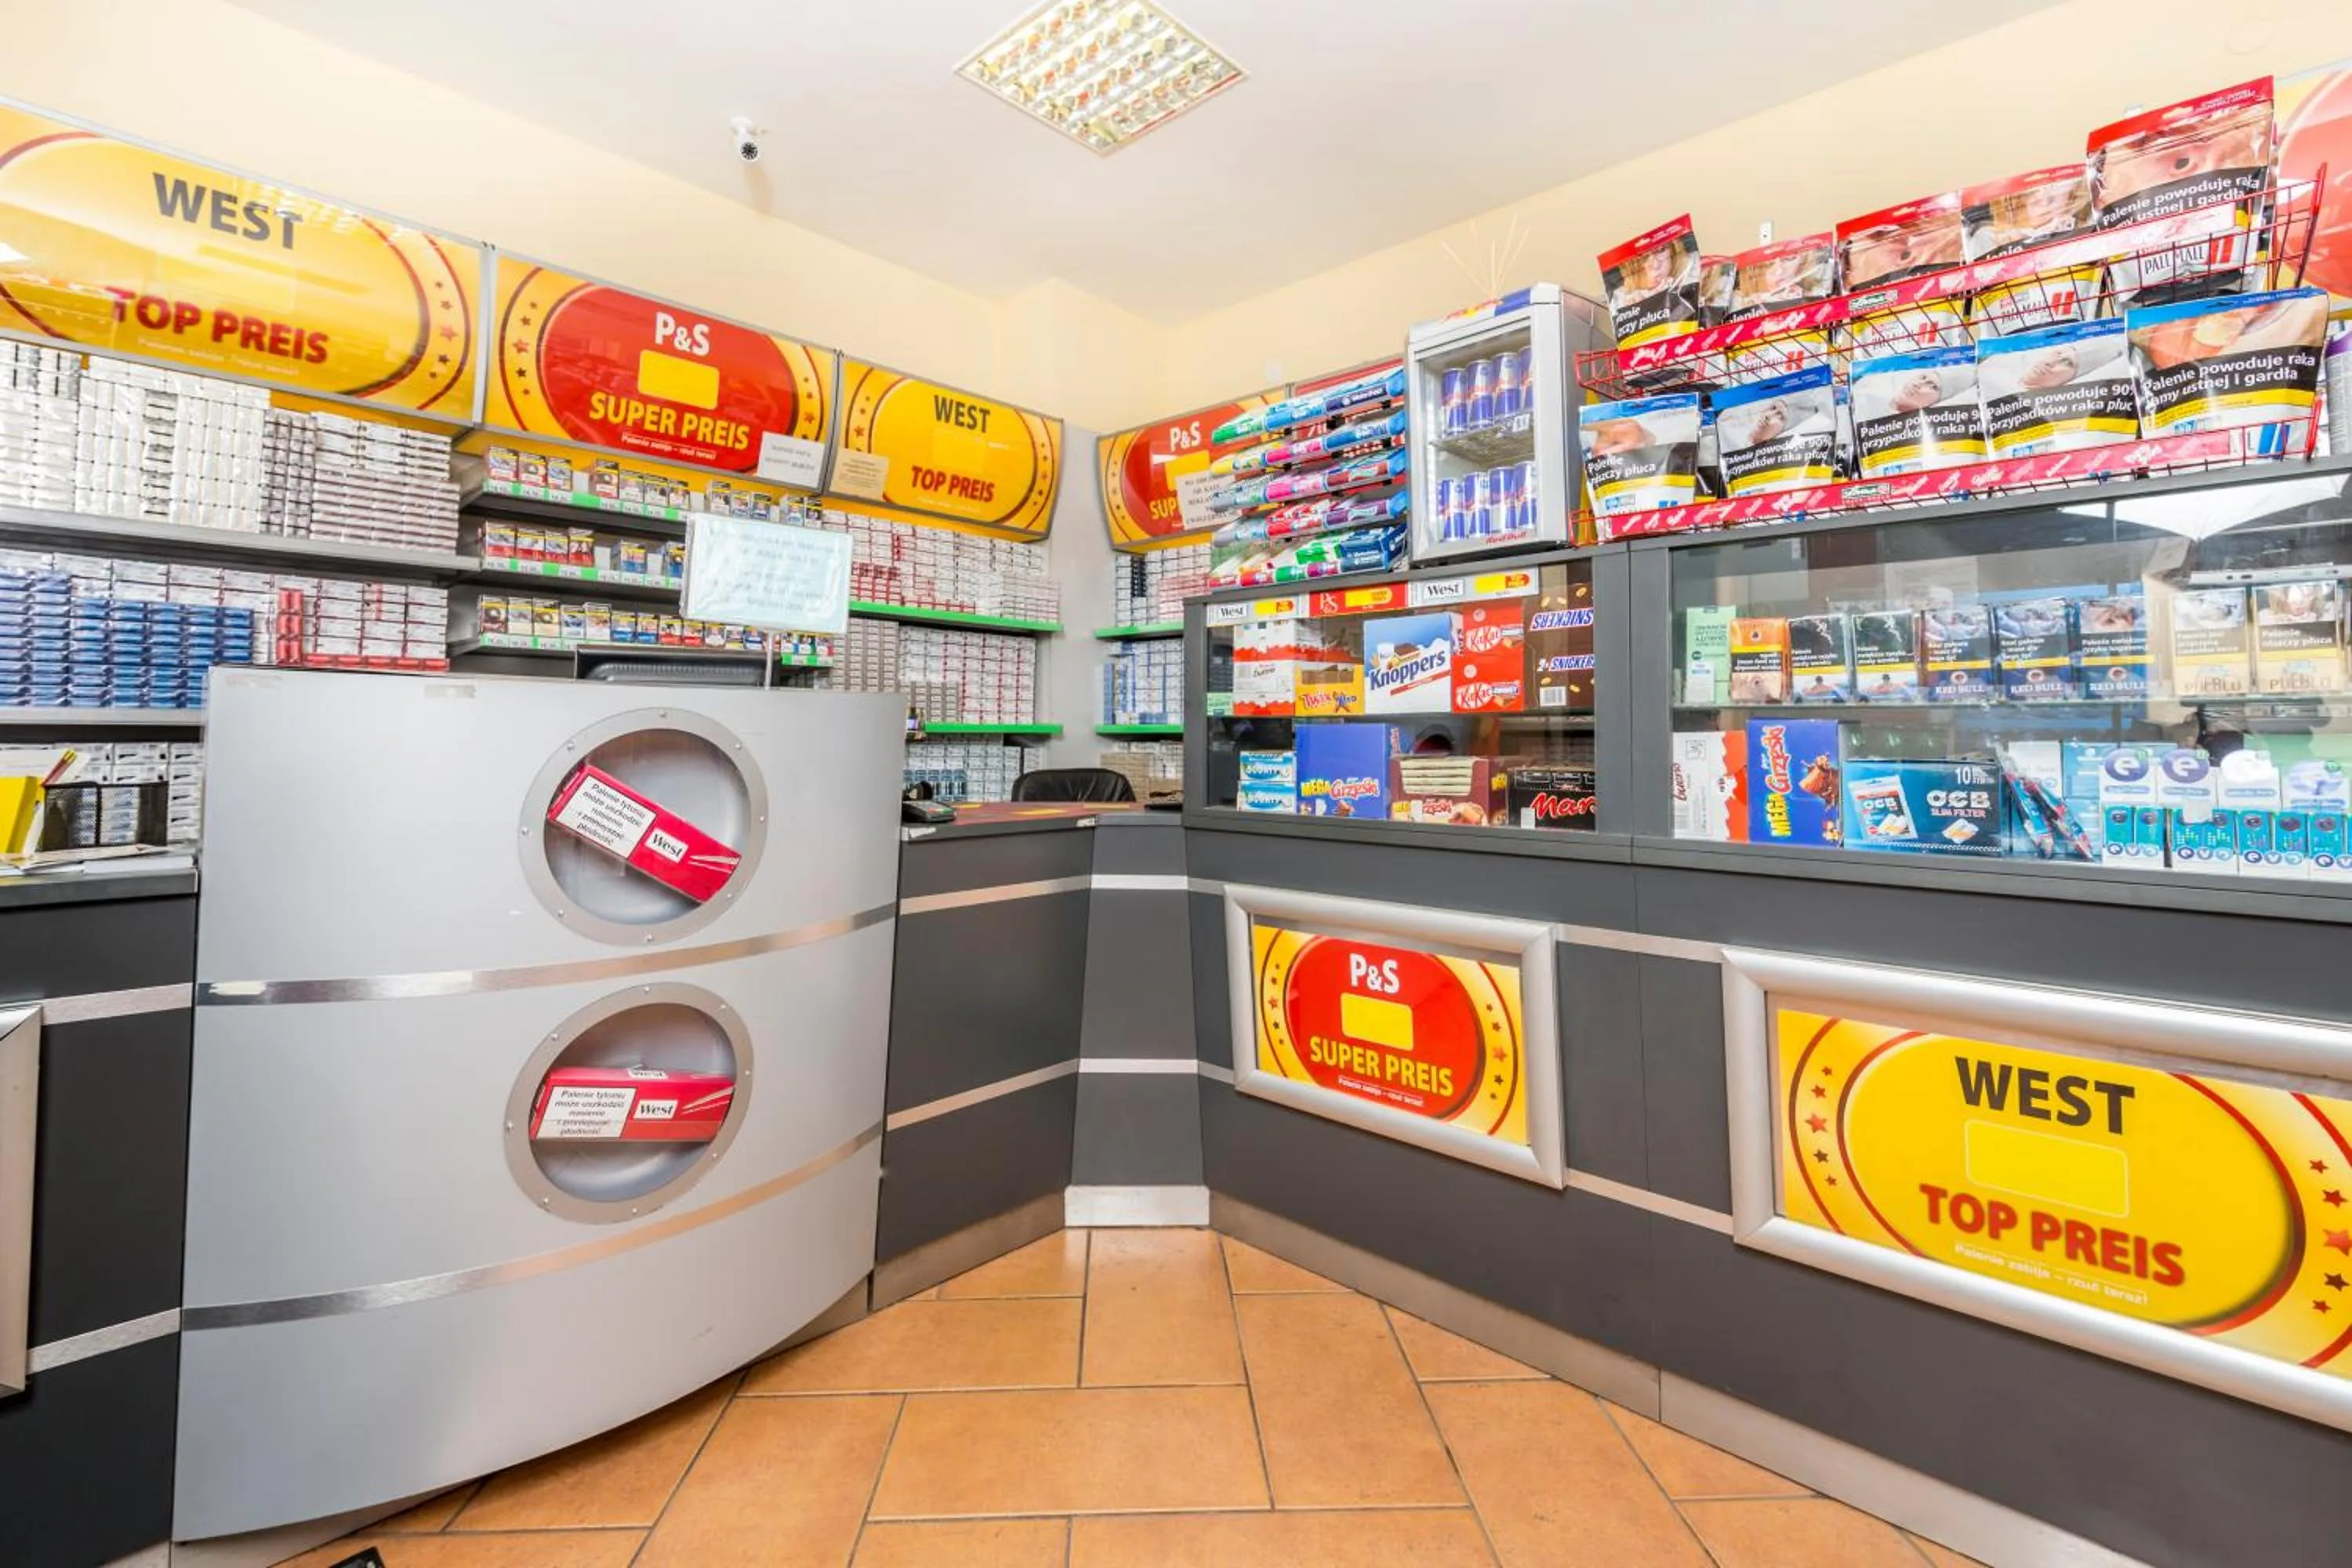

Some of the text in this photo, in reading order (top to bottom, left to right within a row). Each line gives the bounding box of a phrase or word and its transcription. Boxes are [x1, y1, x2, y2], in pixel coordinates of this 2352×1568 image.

[153, 172, 303, 249] WEST
[2103, 197, 2151, 227] Palenie
[2154, 177, 2232, 208] powoduje
[2137, 201, 2184, 223] ustnej
[105, 286, 201, 335] TOP
[212, 310, 328, 364] PREIS
[655, 312, 710, 356] P&S
[2143, 353, 2315, 394] Palenie powoduje raka
[2182, 372, 2230, 396] ustnej
[2244, 366, 2298, 387] gardła
[933, 394, 991, 434] WEST
[1987, 396, 2031, 419] Palenie
[2034, 384, 2108, 407] powoduje
[1990, 403, 2068, 431] przypadków
[2071, 400, 2104, 413] raka
[2107, 398, 2132, 413] płuc
[589, 392, 750, 451] SUPER PREIS
[1860, 419, 1903, 437] Palenie
[1906, 410, 1969, 427] powoduje
[1937, 424, 1965, 435] raka
[1170, 421, 1201, 452] P&S
[1624, 463, 1657, 477] płuca
[1777, 453, 1802, 463] raka
[912, 466, 946, 492] TOP
[948, 474, 995, 503] PREIS
[1149, 497, 1176, 520] SUP
[1427, 583, 1459, 596] West
[1221, 607, 1243, 617] West
[1370, 650, 1446, 691] Knoppers
[1551, 655, 1593, 669] SNICKER
[1461, 683, 1490, 708] KitKat
[2011, 684, 2033, 694] RED
[1955, 767, 1971, 785] 10
[1531, 791, 1596, 820] Mar
[1926, 789, 1991, 809] OCB
[1931, 808, 1986, 818] SLIM FILTER
[652, 833, 683, 858] West
[1349, 953, 1400, 994] P&S
[1309, 1036, 1454, 1098] SUPER PREIS
[640, 1103, 673, 1116] West
[1955, 1055, 2135, 1136] WEST
[1919, 1182, 2186, 1287] TOP PREIS
